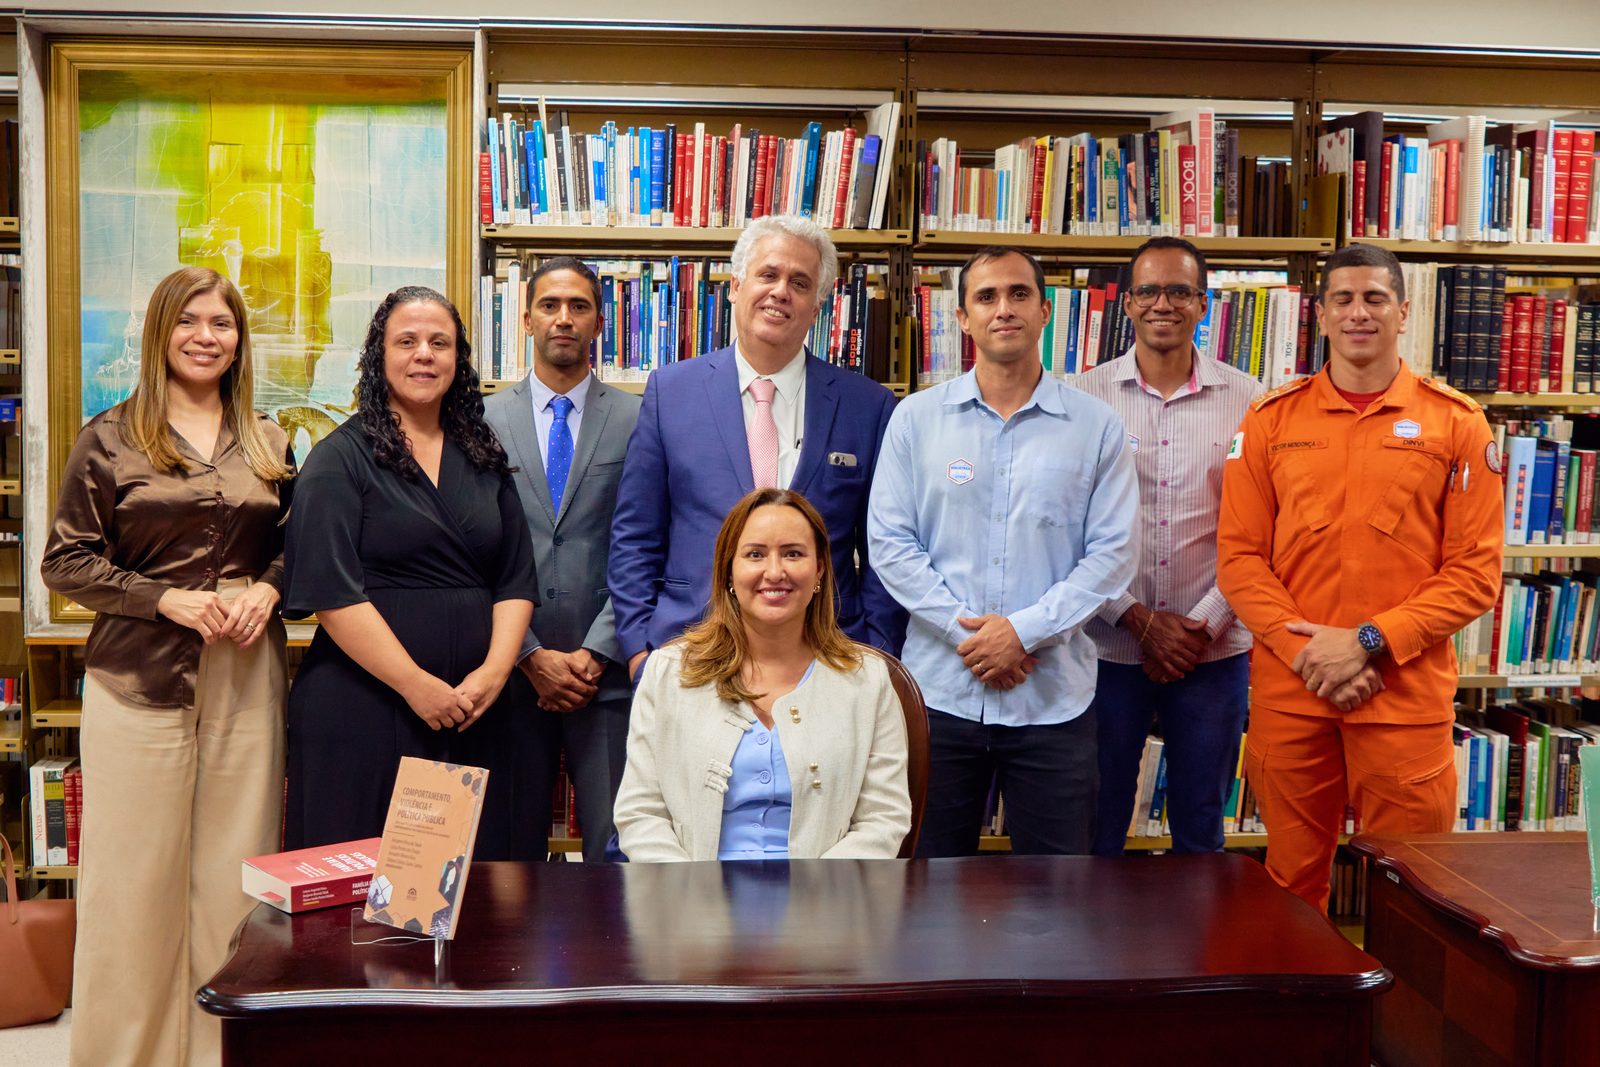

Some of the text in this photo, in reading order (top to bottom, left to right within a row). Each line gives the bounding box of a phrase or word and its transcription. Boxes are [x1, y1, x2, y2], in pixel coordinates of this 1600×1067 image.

[1182, 160, 1195, 202] BOOK
[1228, 172, 1237, 202] BOOK
[856, 357, 862, 366] de
[399, 798, 428, 810] VIOLÊNCIA
[396, 809, 421, 821] POLÍTICA
[420, 813, 446, 826] PÚBLICA
